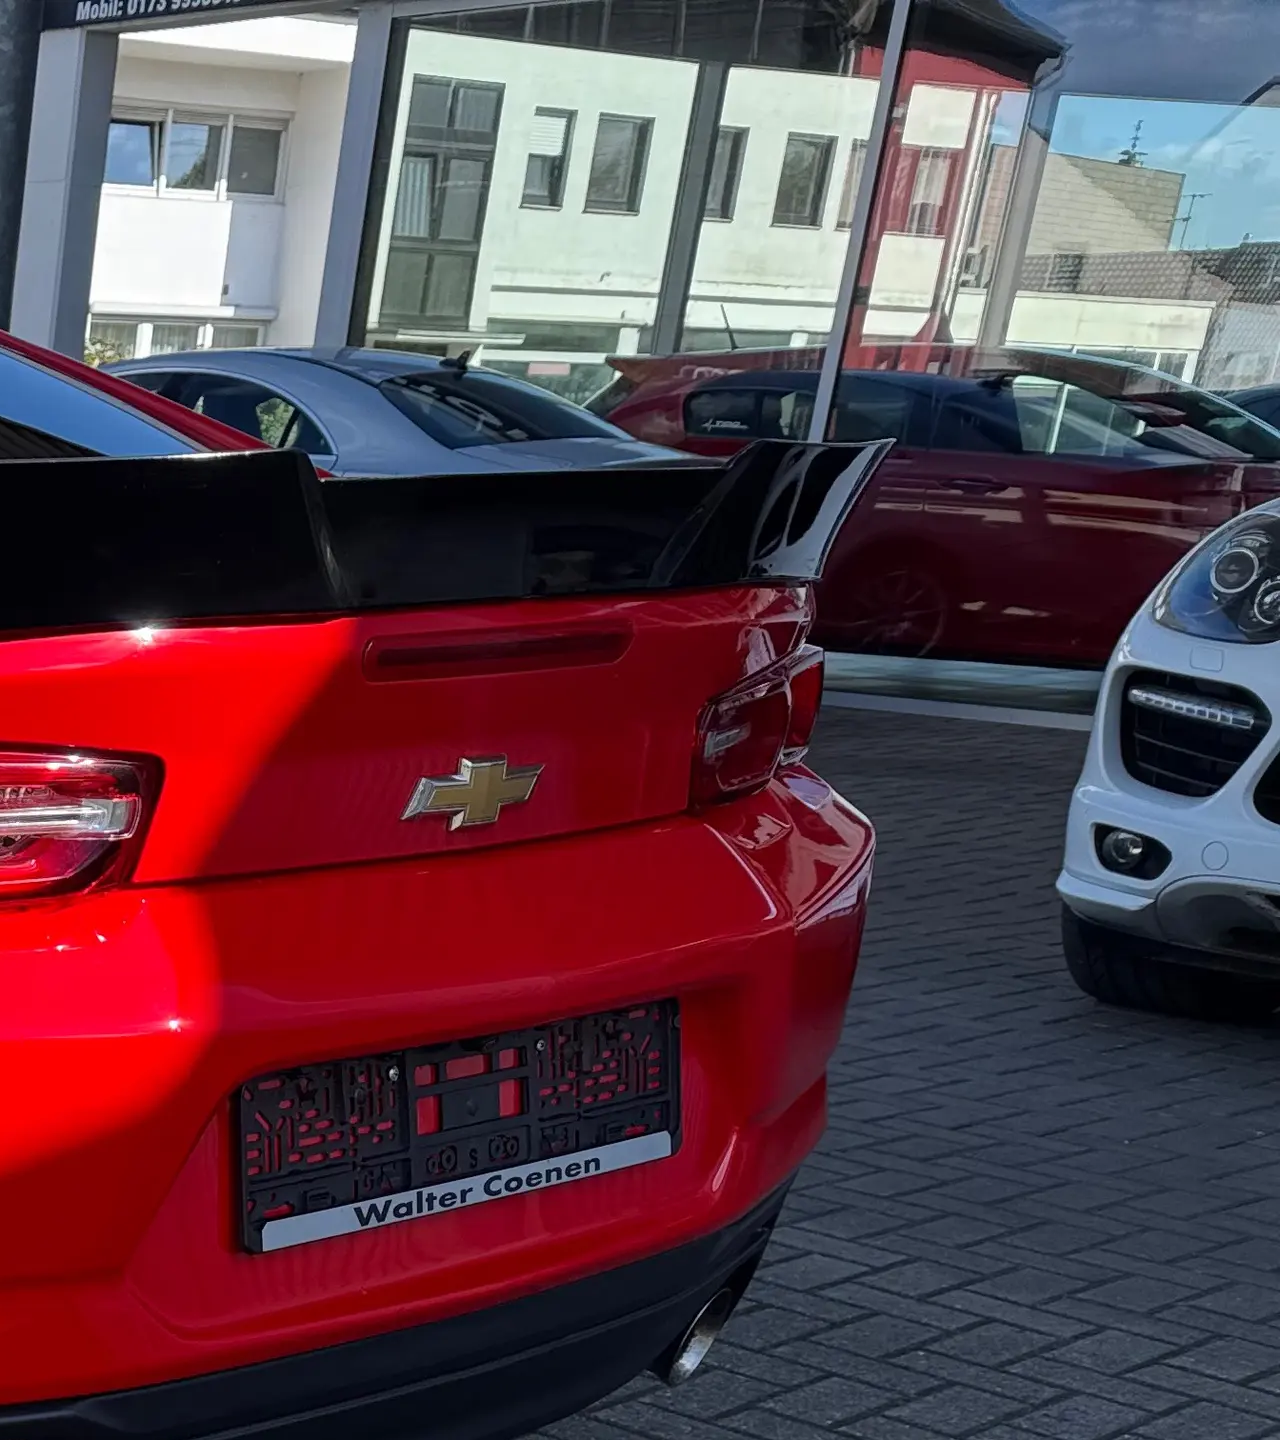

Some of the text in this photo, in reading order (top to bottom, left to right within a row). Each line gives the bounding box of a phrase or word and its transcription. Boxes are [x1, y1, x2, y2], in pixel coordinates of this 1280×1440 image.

[75, 0, 123, 21] Mobil:
[353, 1157, 601, 1228] Walter Coenen
